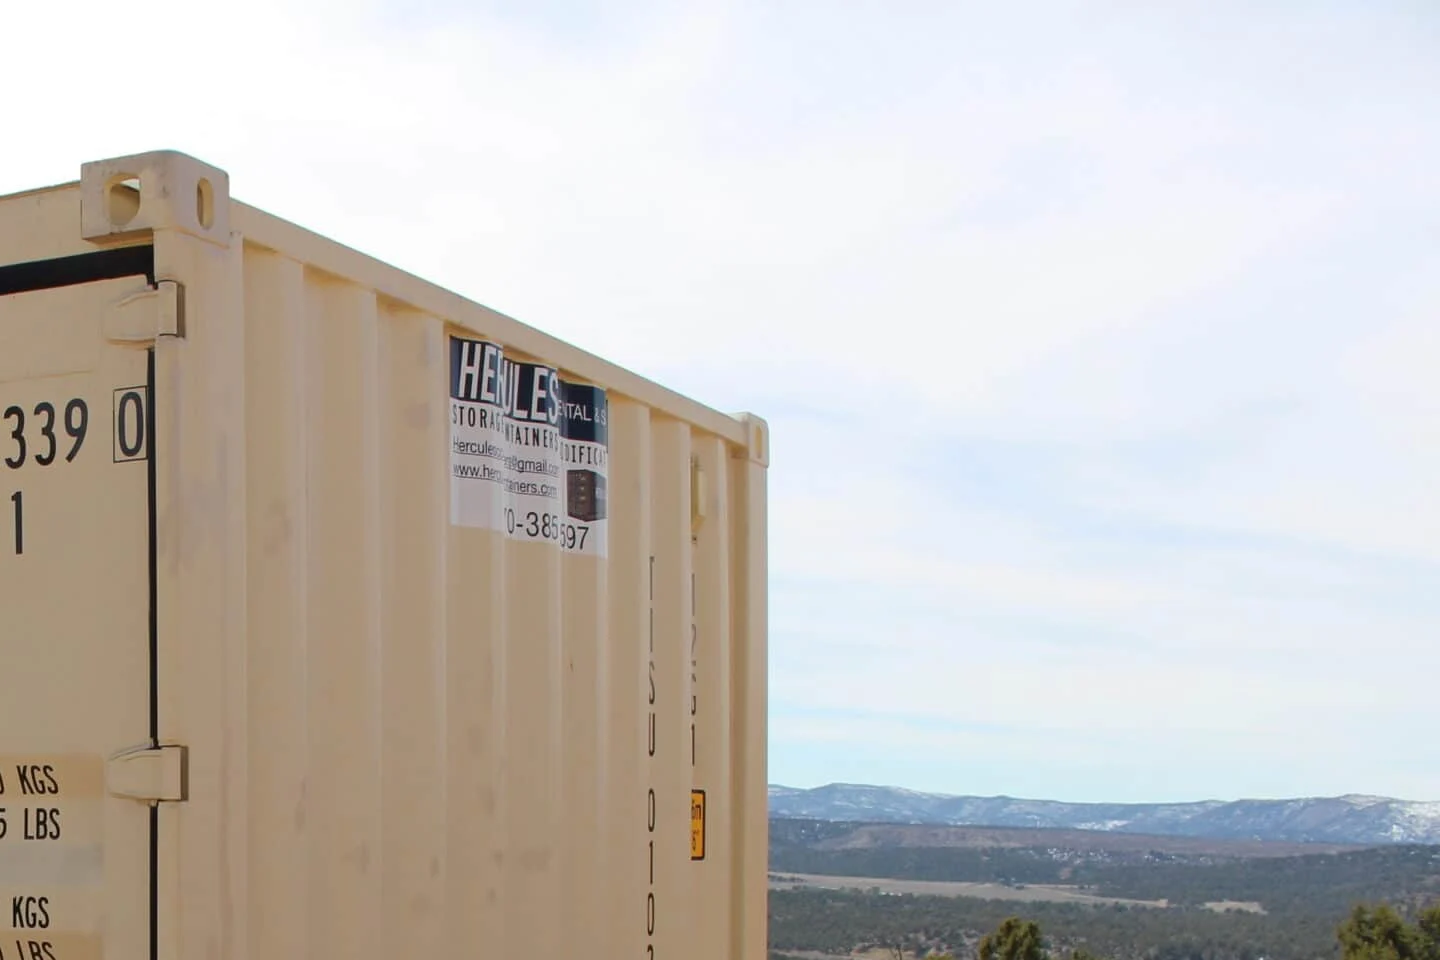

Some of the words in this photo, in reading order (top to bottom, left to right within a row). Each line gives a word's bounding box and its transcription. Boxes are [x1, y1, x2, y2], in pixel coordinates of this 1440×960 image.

[118, 391, 144, 457] 0
[16, 765, 59, 795] KGS
[23, 807, 61, 840] LBS
[12, 896, 50, 928] KGS
